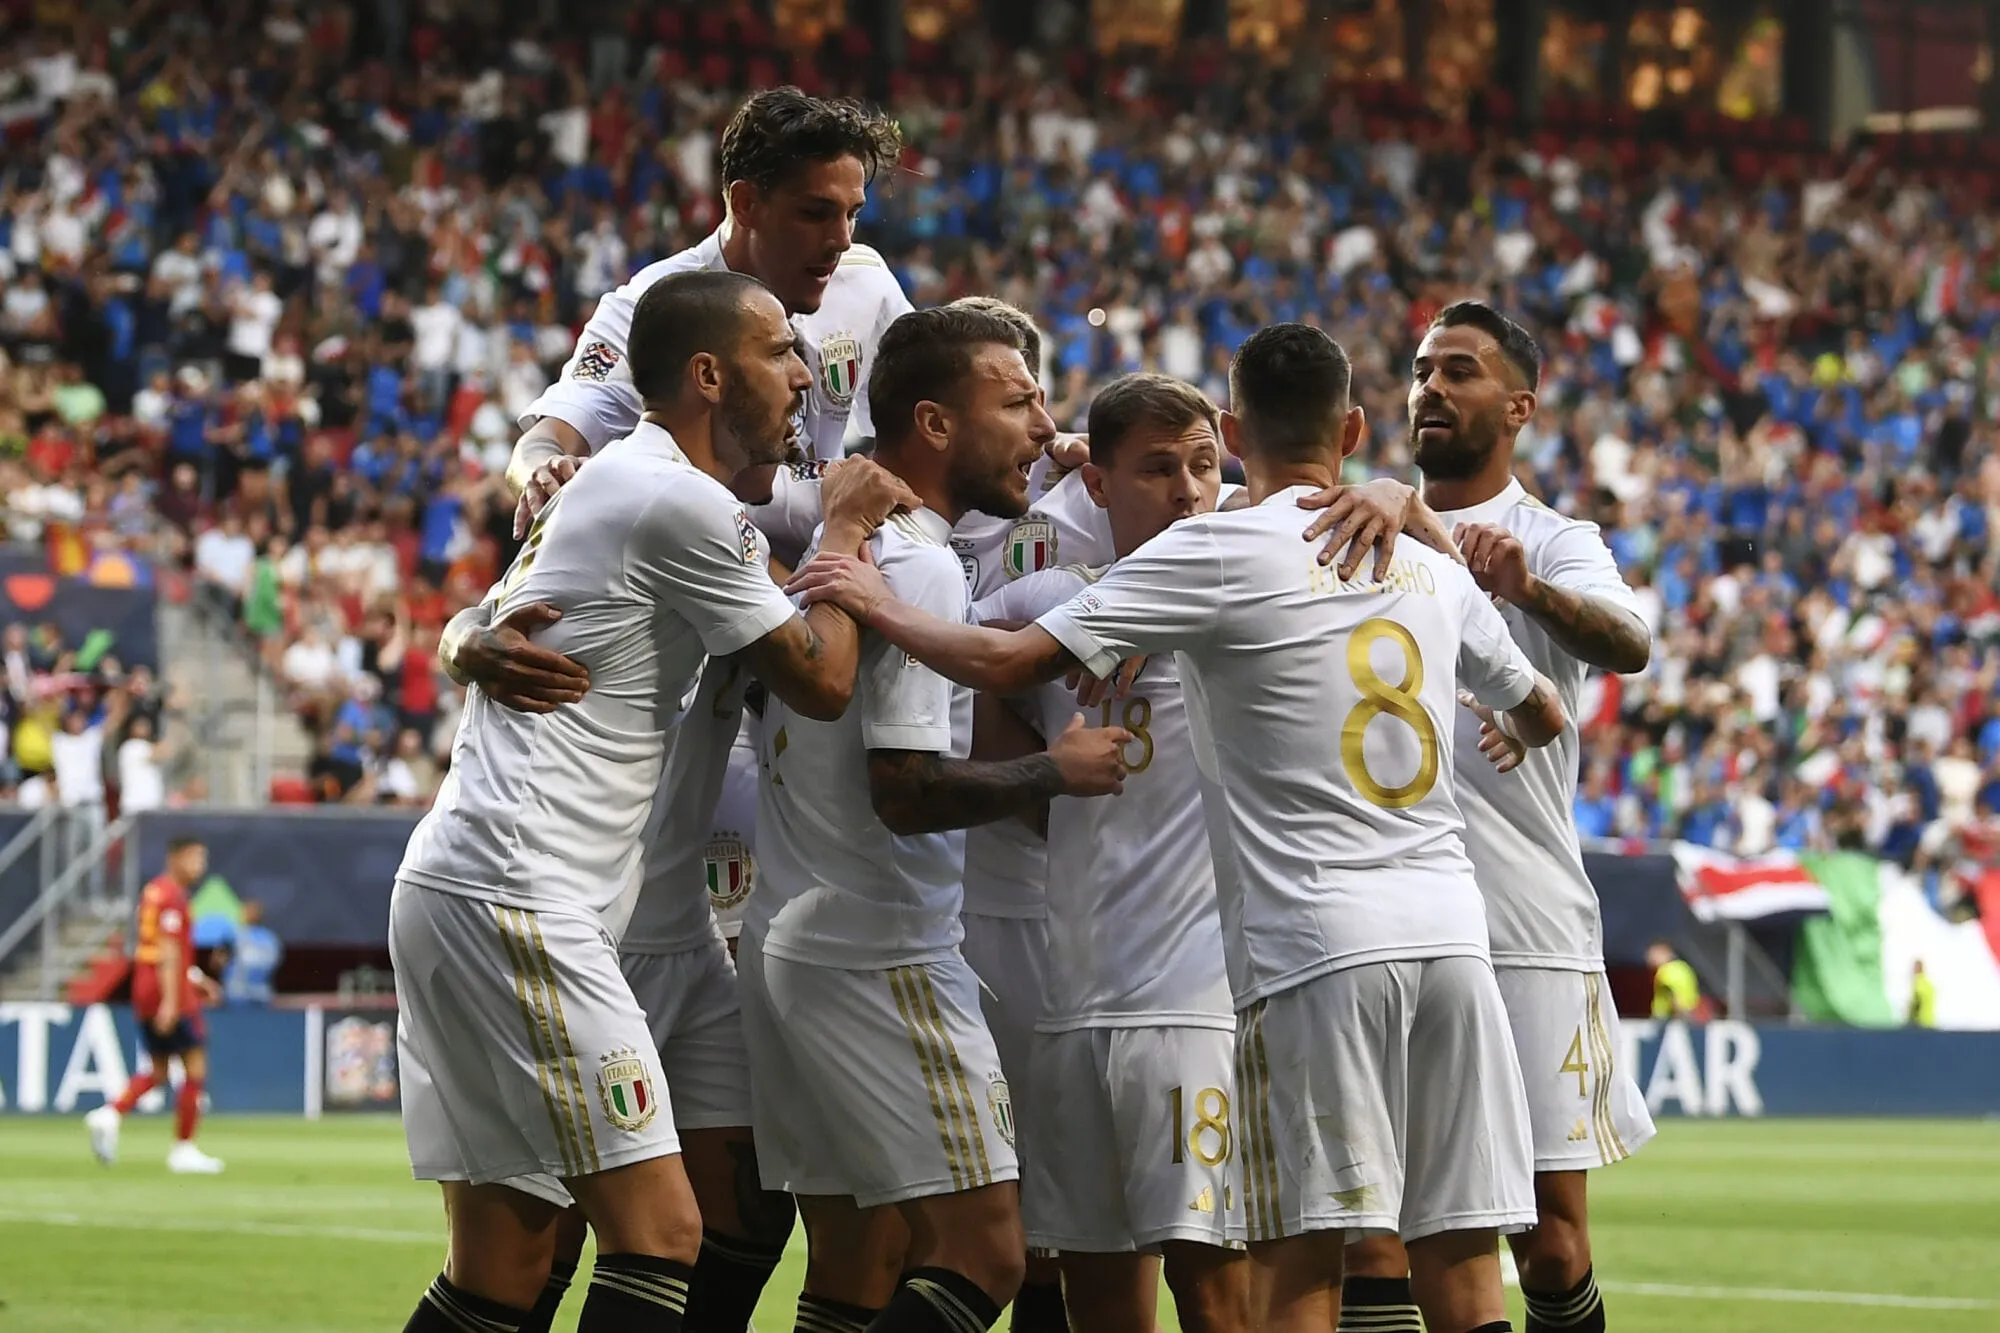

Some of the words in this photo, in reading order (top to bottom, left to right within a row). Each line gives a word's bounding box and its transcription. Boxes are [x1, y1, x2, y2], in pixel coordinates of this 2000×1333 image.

[826, 344, 853, 359] ITALIA
[1013, 525, 1046, 538] ITALIA
[1340, 618, 1438, 807] 8
[705, 845, 738, 857] ITALIA
[1560, 1024, 1588, 1096] 4
[606, 1065, 641, 1080] ITALIA
[1169, 1085, 1233, 1167] 18
